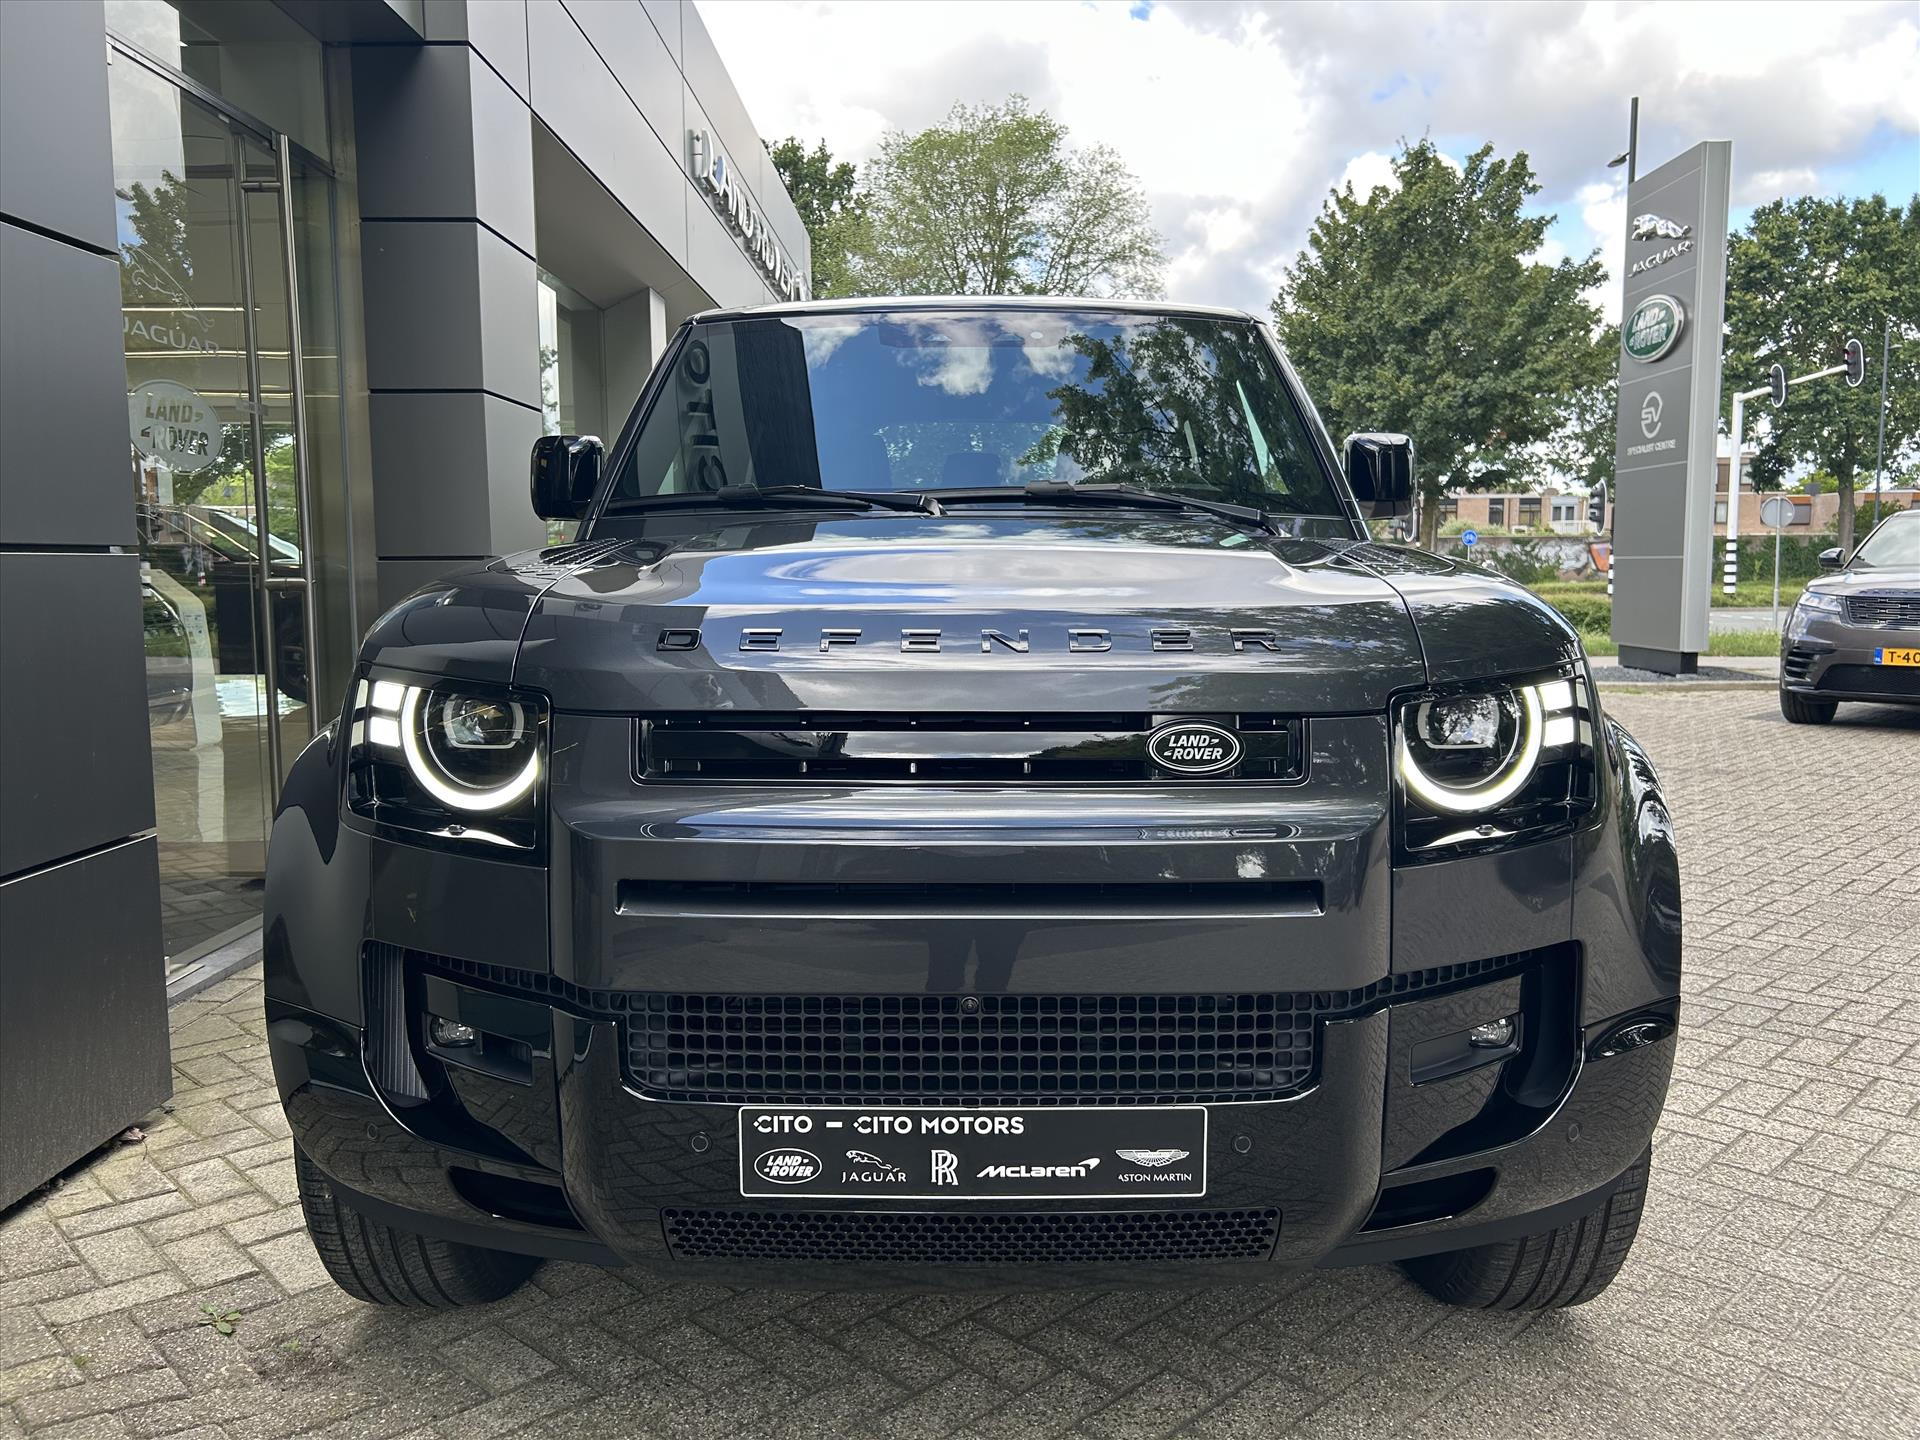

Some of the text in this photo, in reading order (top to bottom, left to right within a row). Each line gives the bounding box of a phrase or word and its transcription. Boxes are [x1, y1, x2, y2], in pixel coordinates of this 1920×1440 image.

[1628, 240, 1692, 278] JAGUAR
[1632, 306, 1660, 333] LAND
[123, 316, 220, 357] JAGUAR
[1633, 323, 1667, 350] ROVER
[145, 400, 193, 424] LAND
[152, 426, 209, 457] ROVER
[656, 628, 1281, 653] DEFENDER
[1168, 735, 1210, 748] LAND
[1172, 747, 1223, 760] ROVER
[756, 1115, 813, 1134] CITO
[856, 1116, 913, 1135] CITO
[921, 1116, 1025, 1135] MOTORS
[766, 1155, 801, 1167] LAND
[769, 1166, 814, 1178] ROVER
[842, 1171, 907, 1183] JAGUAR
[976, 1165, 1086, 1178] McLaren
[1118, 1173, 1192, 1182] ASTON MARTIN
